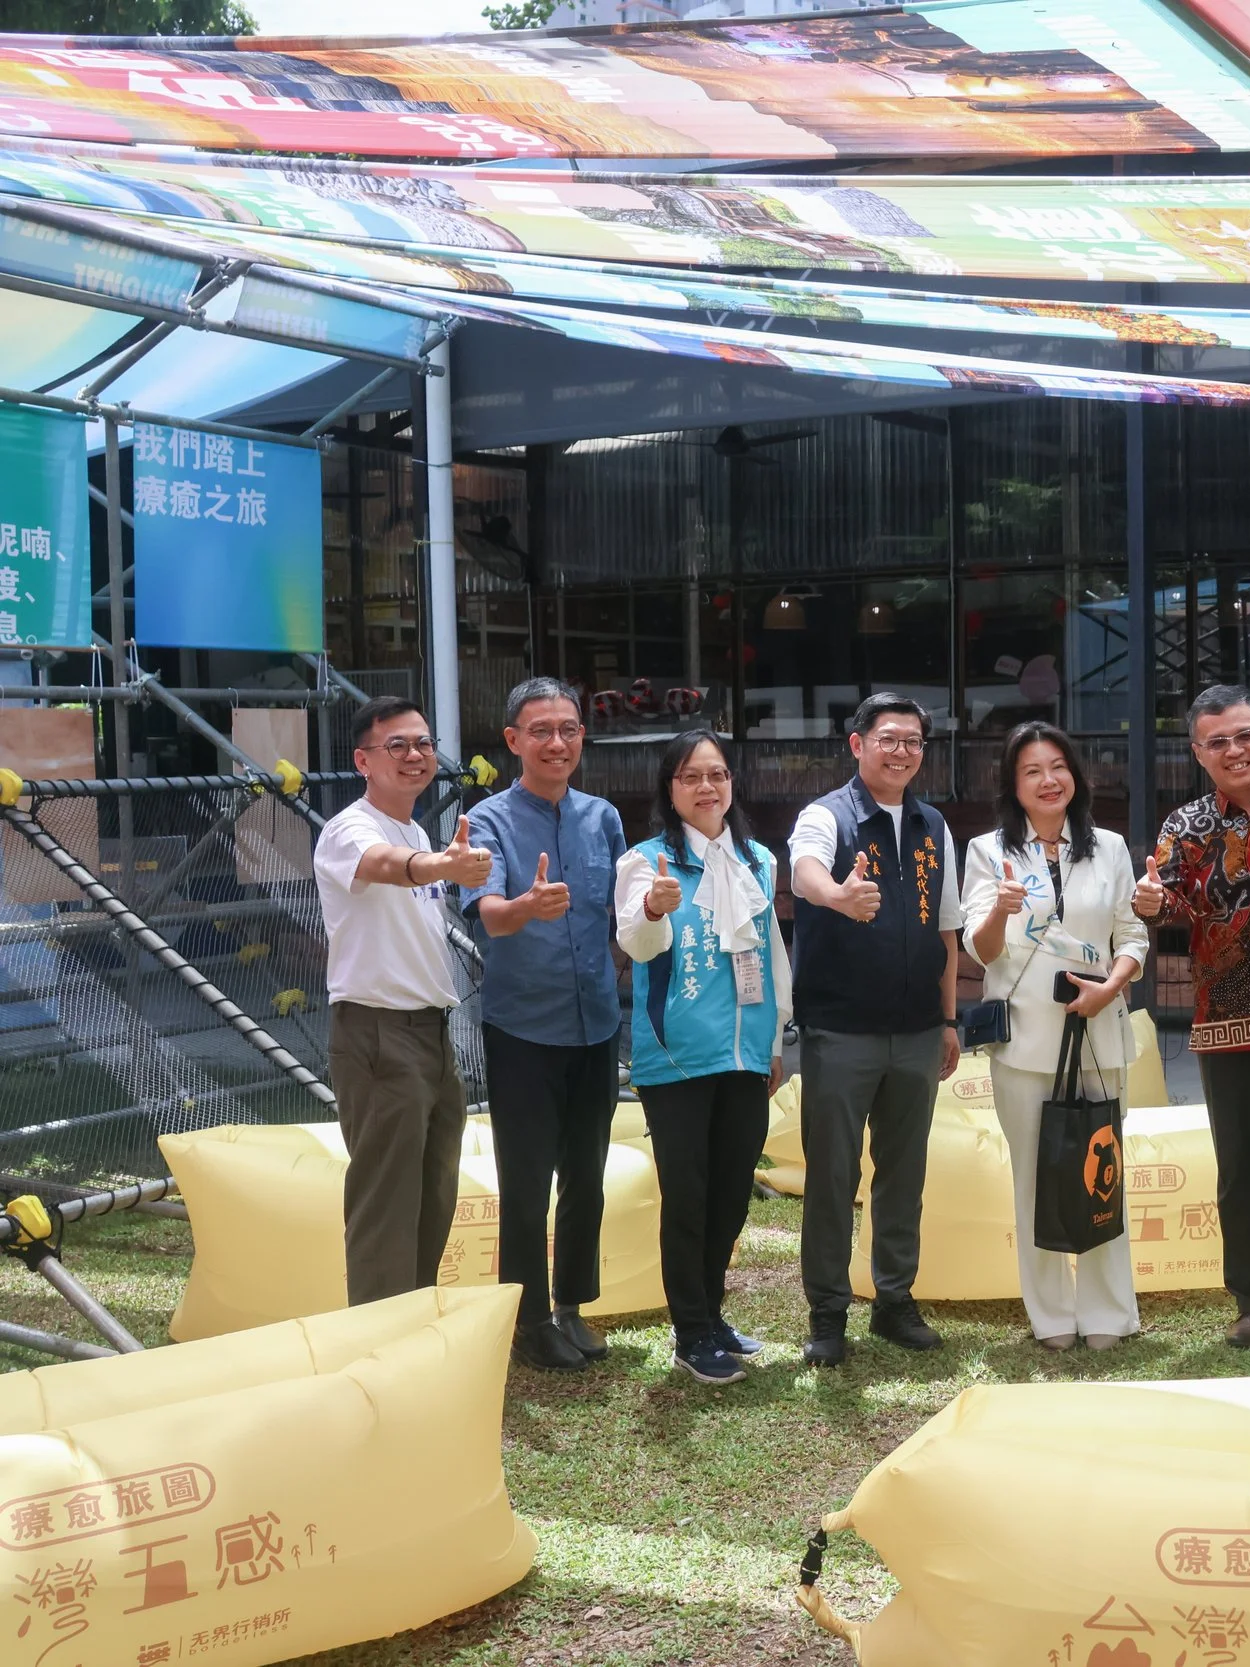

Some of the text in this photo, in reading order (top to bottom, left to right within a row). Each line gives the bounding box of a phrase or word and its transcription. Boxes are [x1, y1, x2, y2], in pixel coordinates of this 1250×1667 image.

[133, 424, 266, 478] 我們踏上
[134, 475, 267, 527] 療癒之旅
[869, 843, 881, 875] 代表
[913, 849, 930, 925] 鄉民代表會
[680, 924, 702, 1000] 盧玉芳
[1124, 1168, 1178, 1189] 旅圖
[9, 1469, 201, 1541] 療愈旅圖
[189, 1623, 288, 1656] borderless
[191, 1607, 292, 1648] 无界行销所
